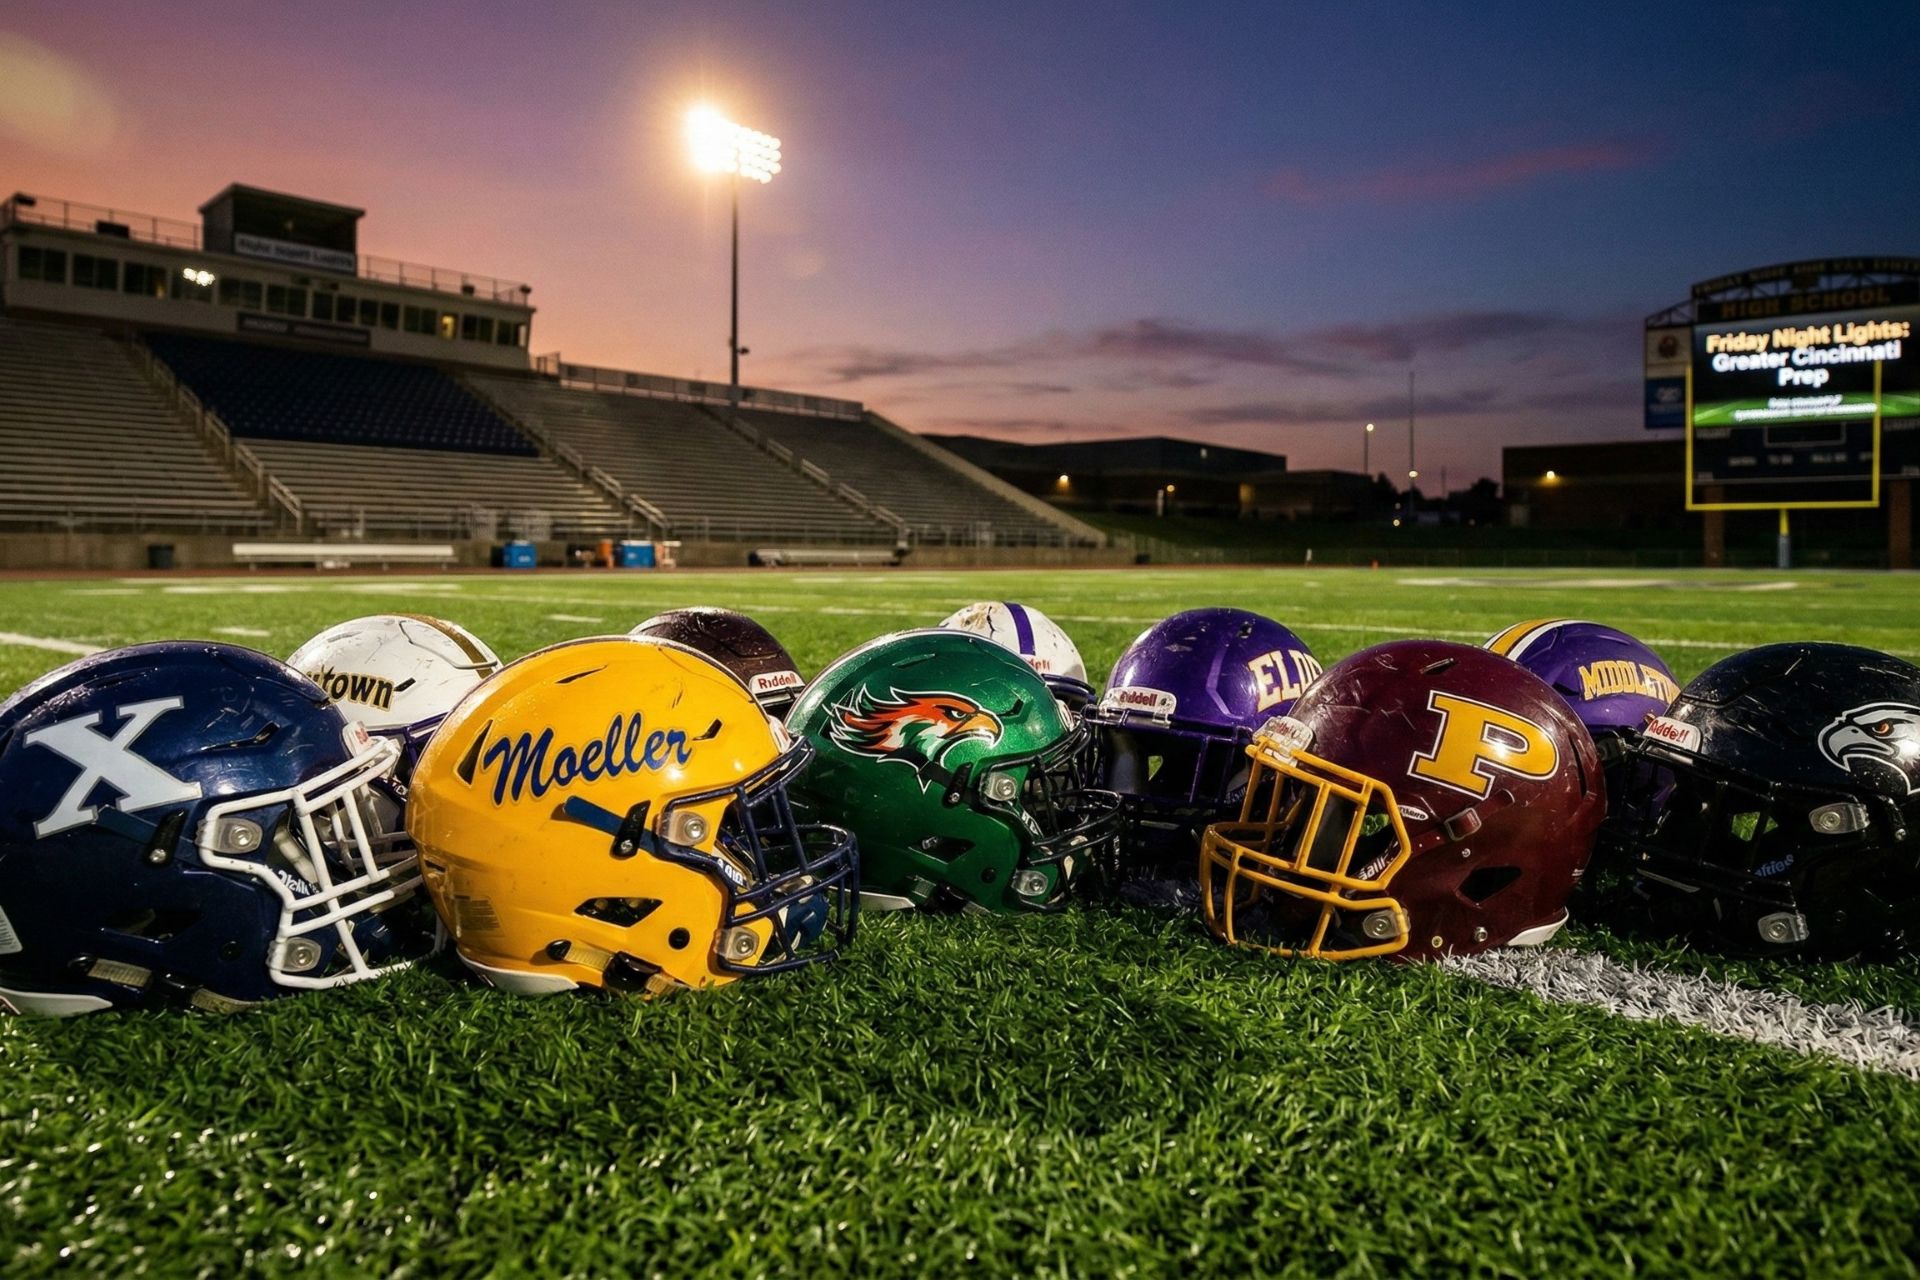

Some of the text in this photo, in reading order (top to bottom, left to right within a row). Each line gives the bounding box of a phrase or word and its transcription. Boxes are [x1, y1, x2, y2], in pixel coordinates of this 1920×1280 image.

[1790, 287, 1891, 312] SCHOOL
[1706, 320, 1910, 353] Friday Night Lights:
[1712, 340, 1901, 372] Greater Cincinnati
[1778, 367, 1829, 388] Prep
[483, 711, 692, 806] Moeller
[1407, 690, 1559, 800] P
[24, 696, 202, 838] X
